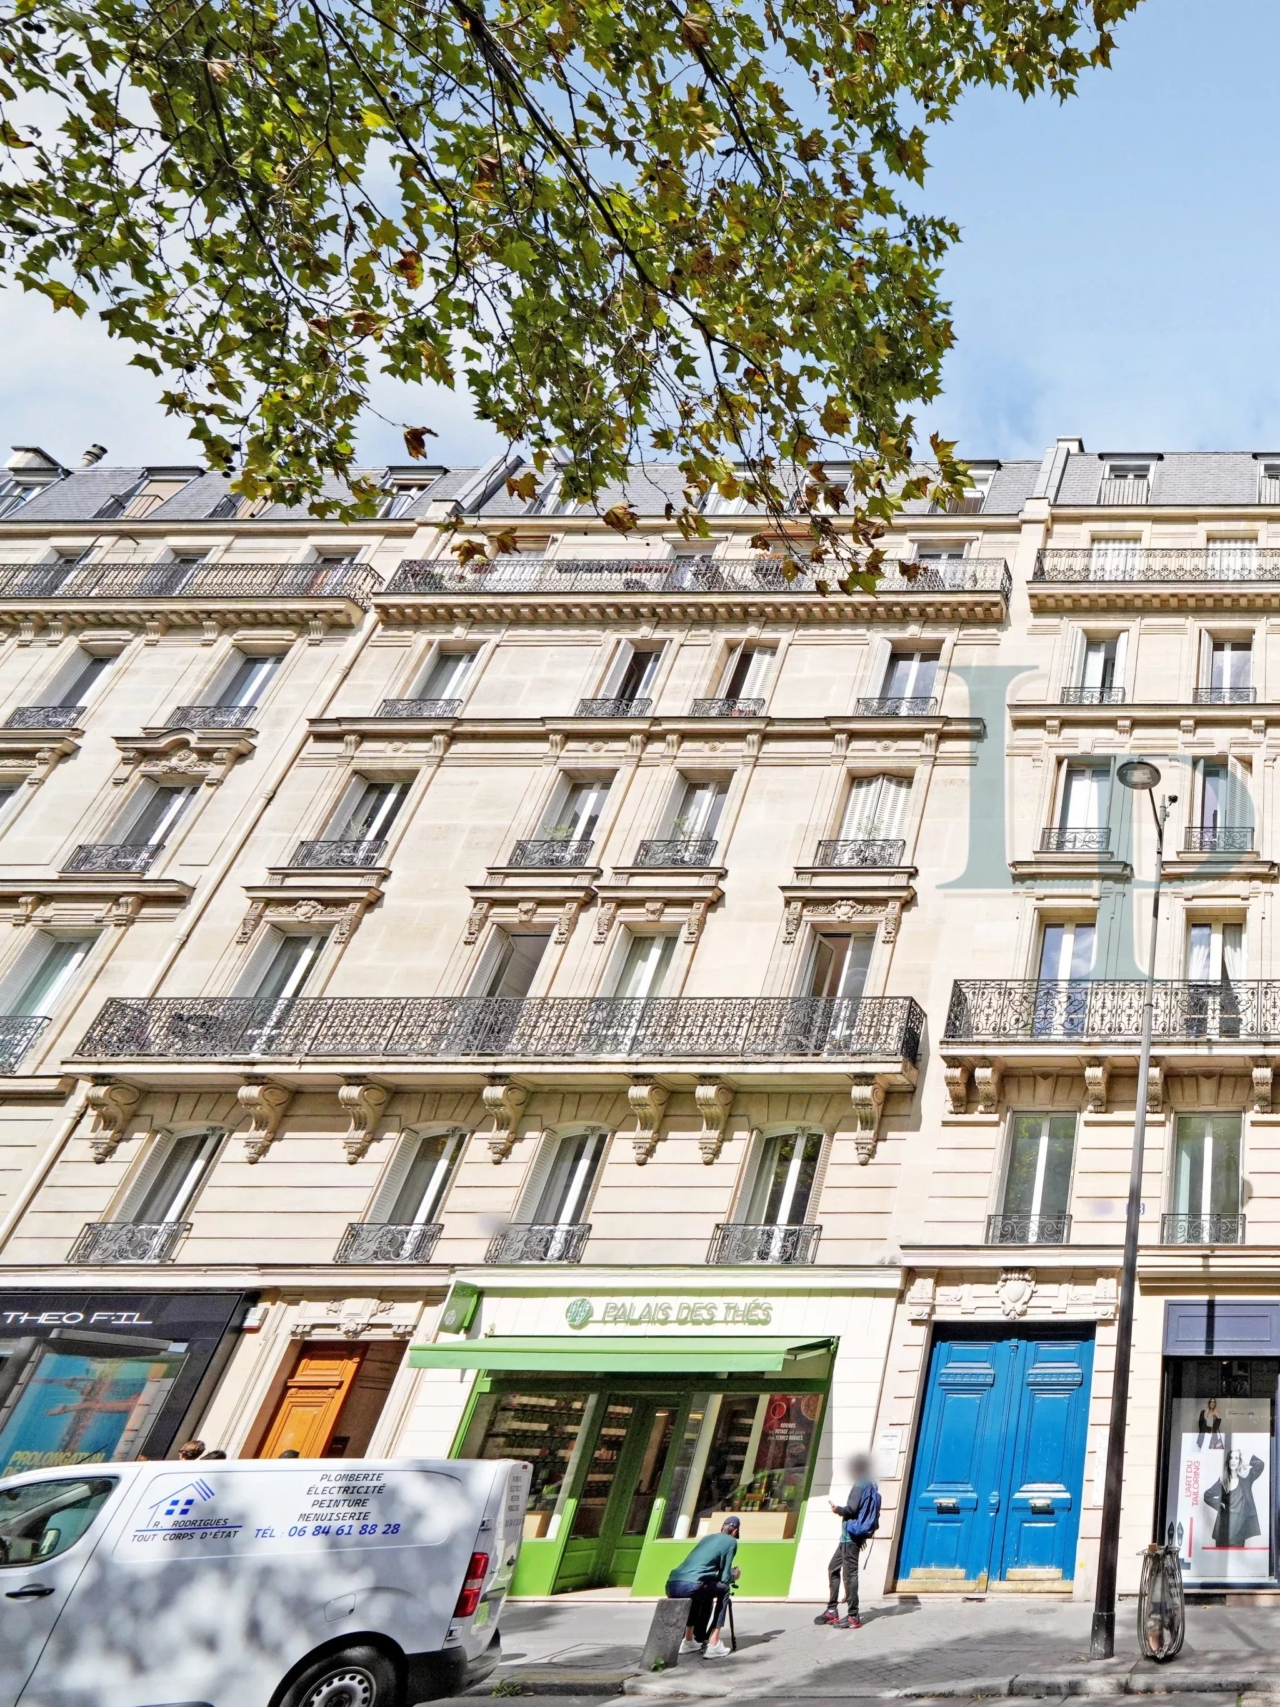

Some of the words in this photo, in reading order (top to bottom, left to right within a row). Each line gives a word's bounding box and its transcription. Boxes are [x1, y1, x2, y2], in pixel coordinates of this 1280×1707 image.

[601, 1302, 673, 1325] PALAIS
[675, 1302, 718, 1325] DES
[722, 1298, 774, 1325] THÉS
[3, 1312, 84, 1324] THEO
[1187, 1460, 1193, 1473] DU
[320, 1473, 384, 1482] PLOMBERIE
[1192, 1460, 1200, 1507] TAILORING
[306, 1484, 386, 1495] ÉLECTRICITÉ
[1184, 1475, 1193, 1498] L'ART
[311, 1498, 369, 1508] PEINTURE
[297, 1511, 371, 1522] MENUISERIE
[171, 1518, 229, 1528] RODRIGUES
[131, 1533, 158, 1542] TOUT
[162, 1532, 195, 1541] CORPS
[200, 1529, 238, 1540] D'ÉTAT
[254, 1527, 276, 1538] TÉL
[288, 1525, 307, 1537] 06
[311, 1525, 330, 1536] 84
[335, 1525, 352, 1536] 61
[358, 1524, 377, 1535] 88
[381, 1523, 401, 1535] 28
